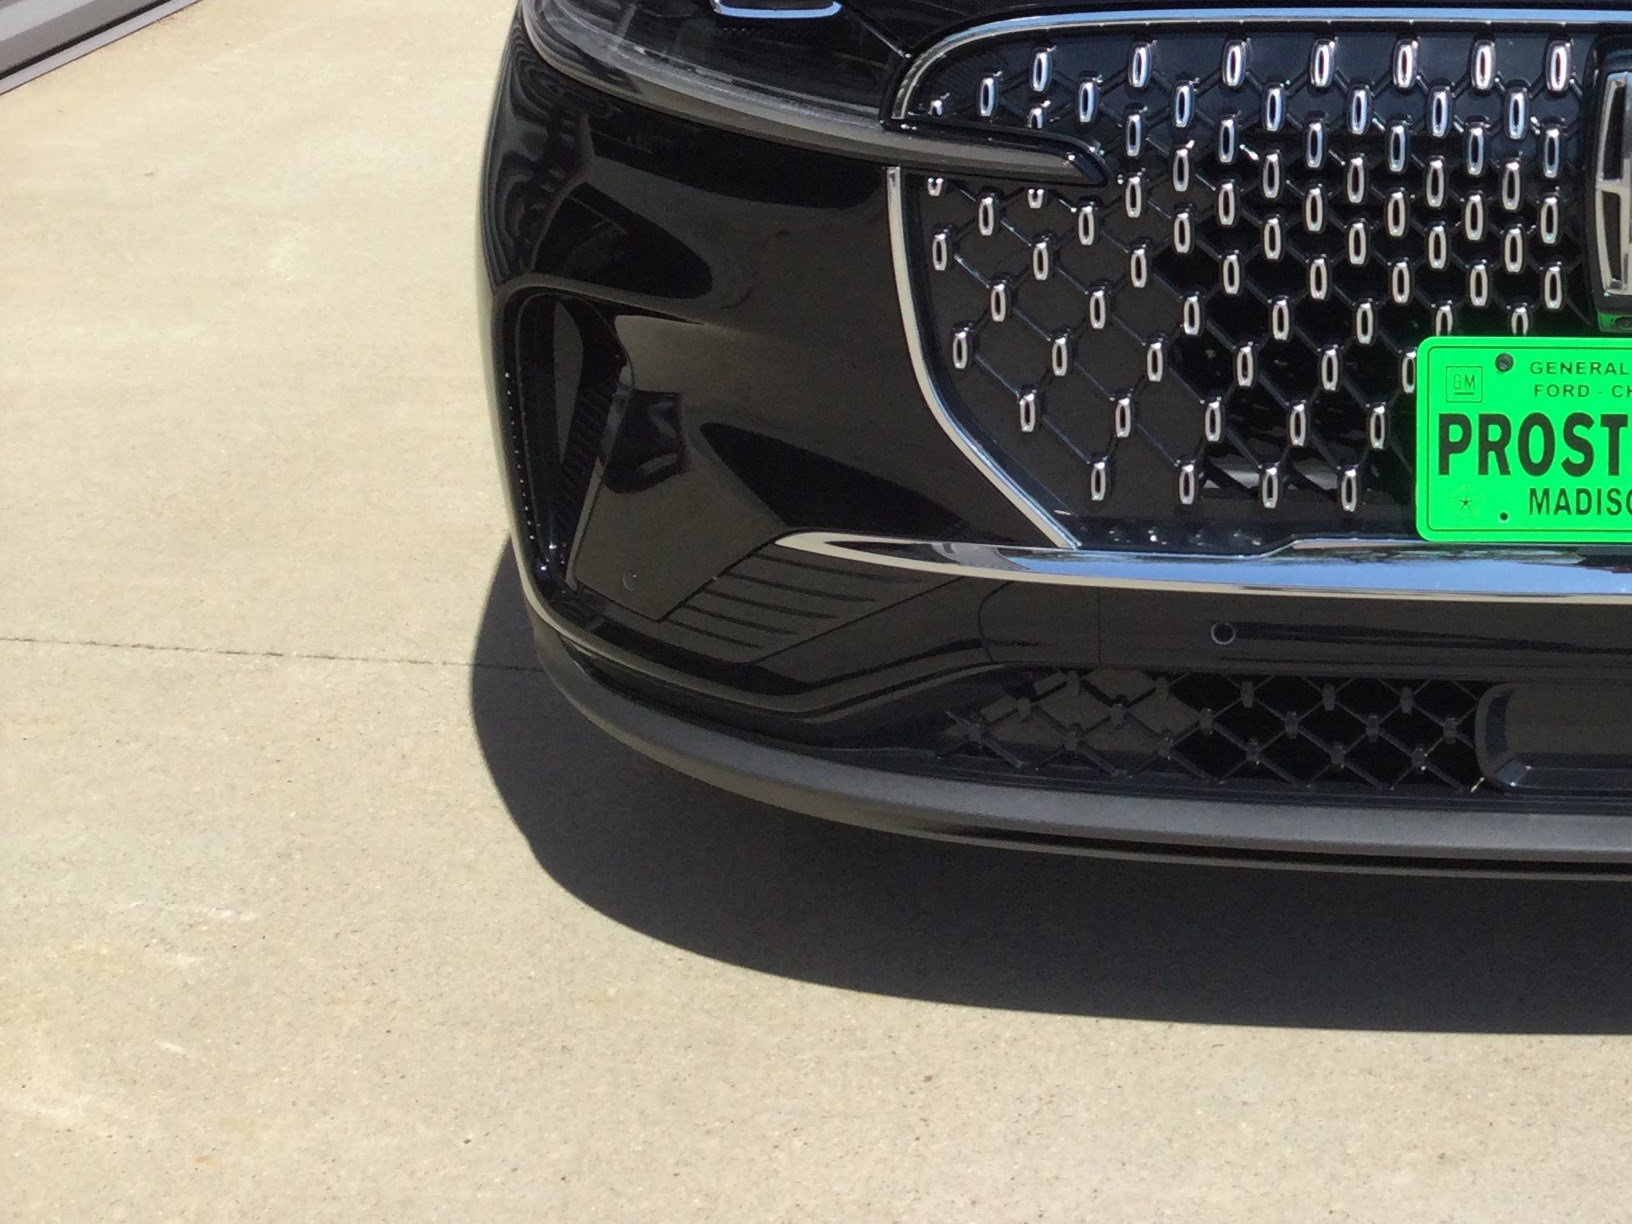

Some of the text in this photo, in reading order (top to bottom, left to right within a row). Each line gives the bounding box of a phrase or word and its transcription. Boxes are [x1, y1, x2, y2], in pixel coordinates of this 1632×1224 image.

[1529, 361, 1630, 376] GENERAL
[1453, 373, 1476, 391] GM
[1533, 384, 1590, 398] FORD
